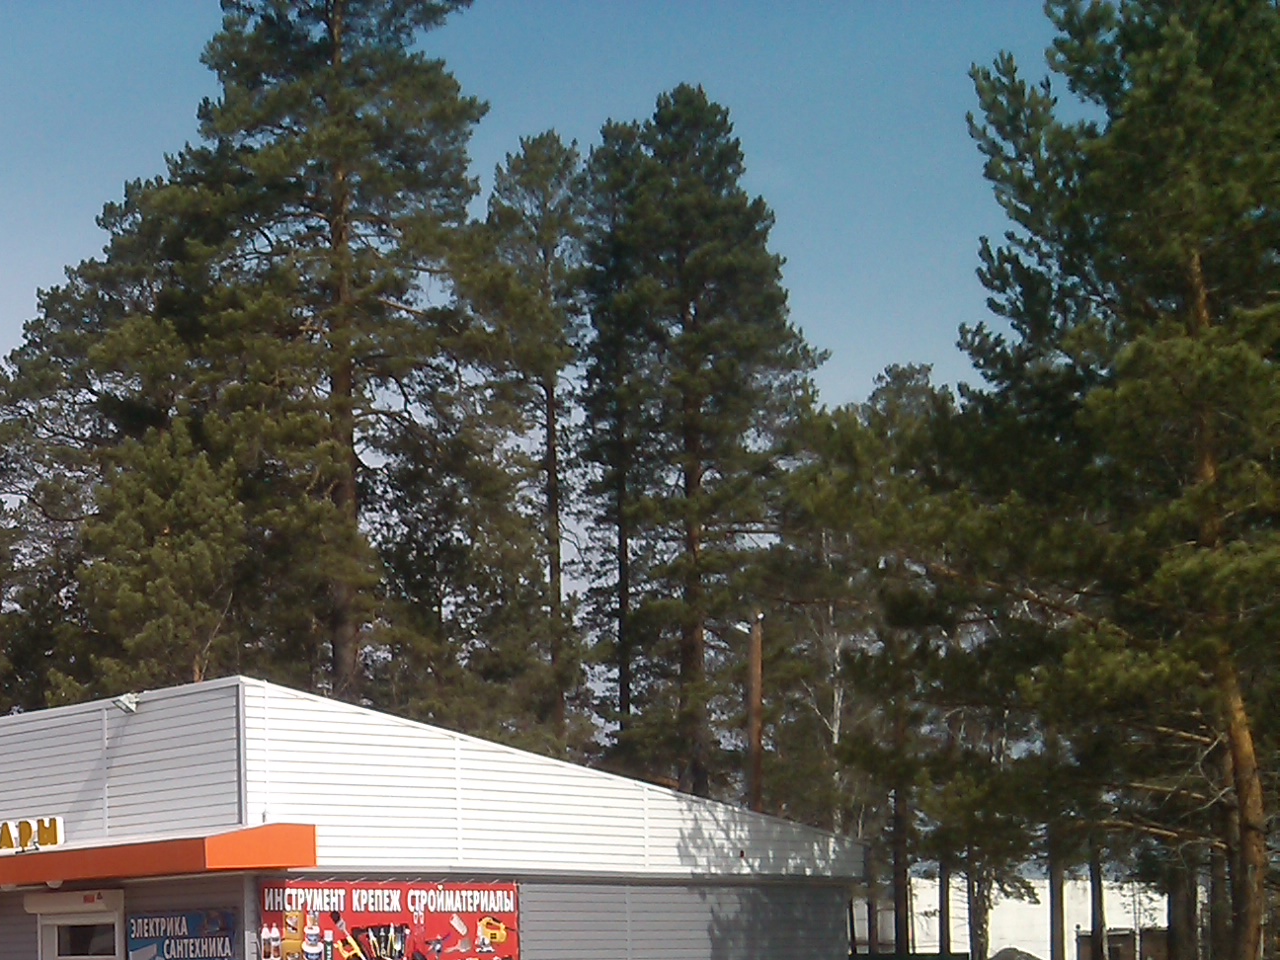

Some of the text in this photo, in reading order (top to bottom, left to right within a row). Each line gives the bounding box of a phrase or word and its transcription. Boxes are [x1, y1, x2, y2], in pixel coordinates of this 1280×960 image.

[264, 885, 515, 912] ИНСТРУМЕНТ КРЕПЕЖ СТРОЙМАТЕРИАЛЫ
[130, 916, 188, 938] ЭЛЕКТРИКА
[163, 937, 231, 959] САНТЕХНИКА
